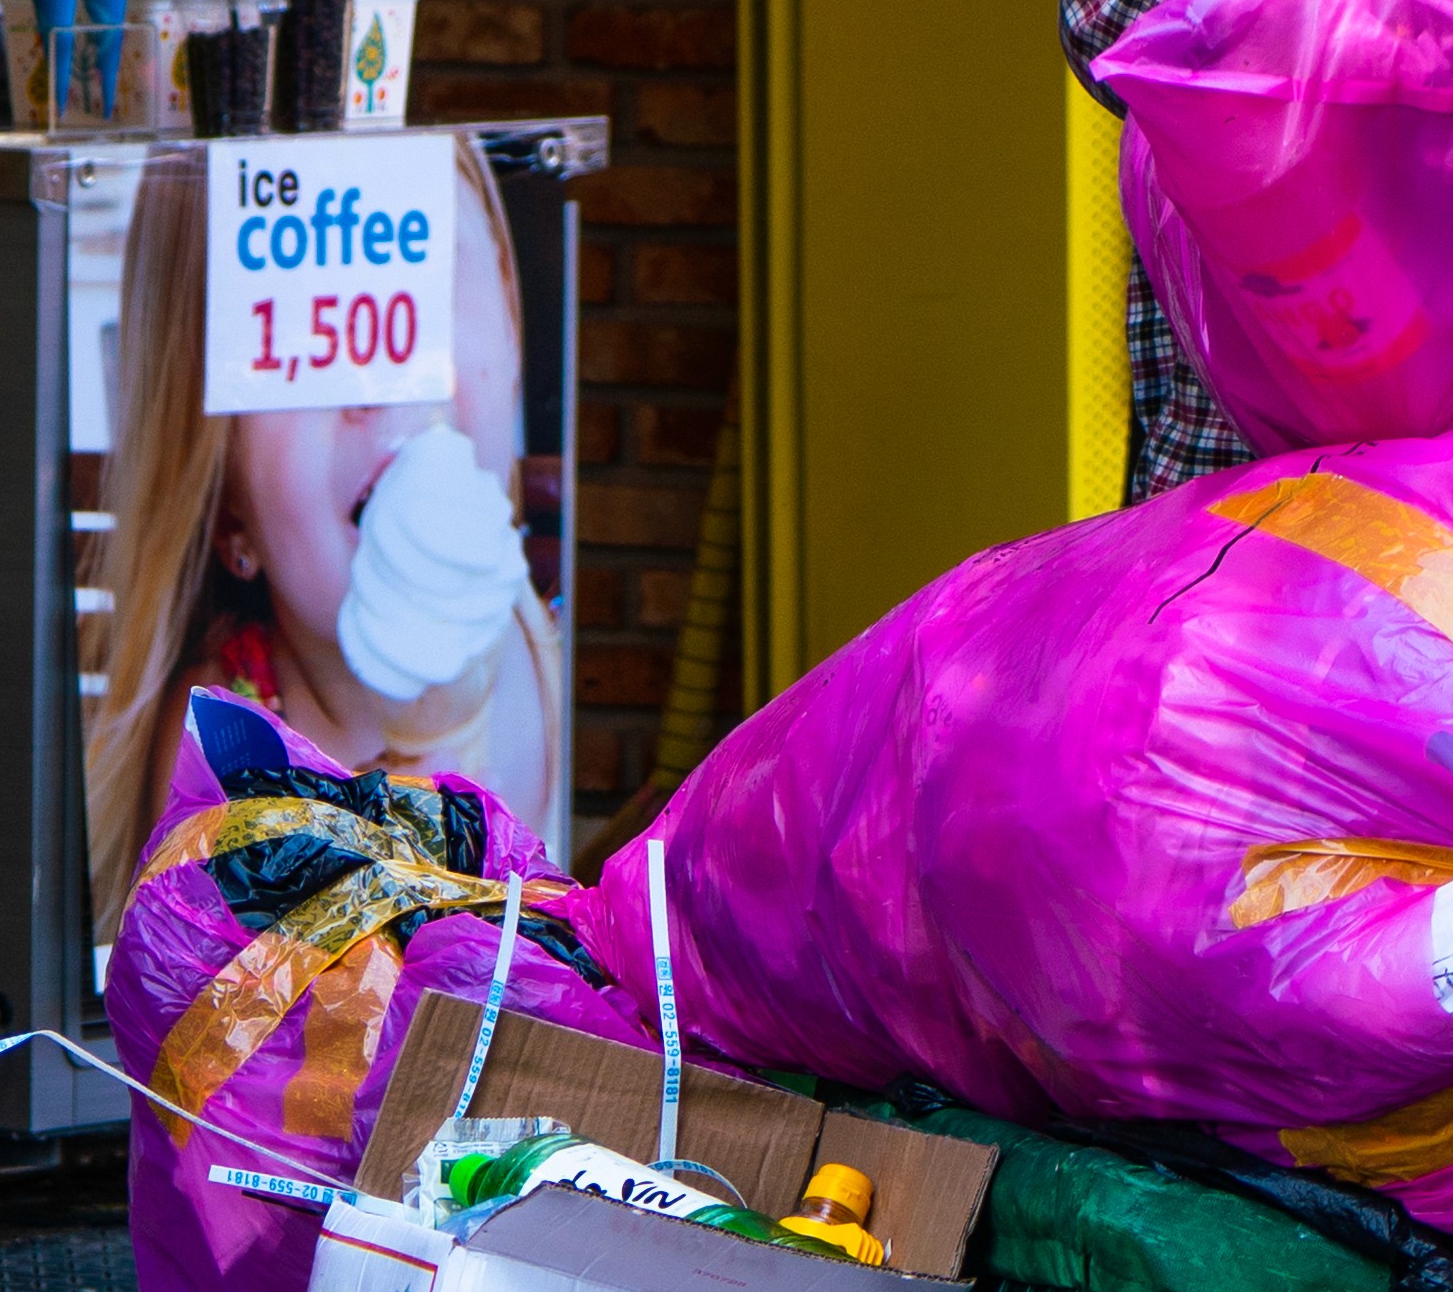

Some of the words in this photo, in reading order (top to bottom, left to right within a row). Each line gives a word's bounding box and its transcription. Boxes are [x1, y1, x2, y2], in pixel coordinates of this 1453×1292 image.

[237, 158, 299, 209] ice
[236, 187, 430, 271] coffee
[250, 290, 418, 383] 1,500
